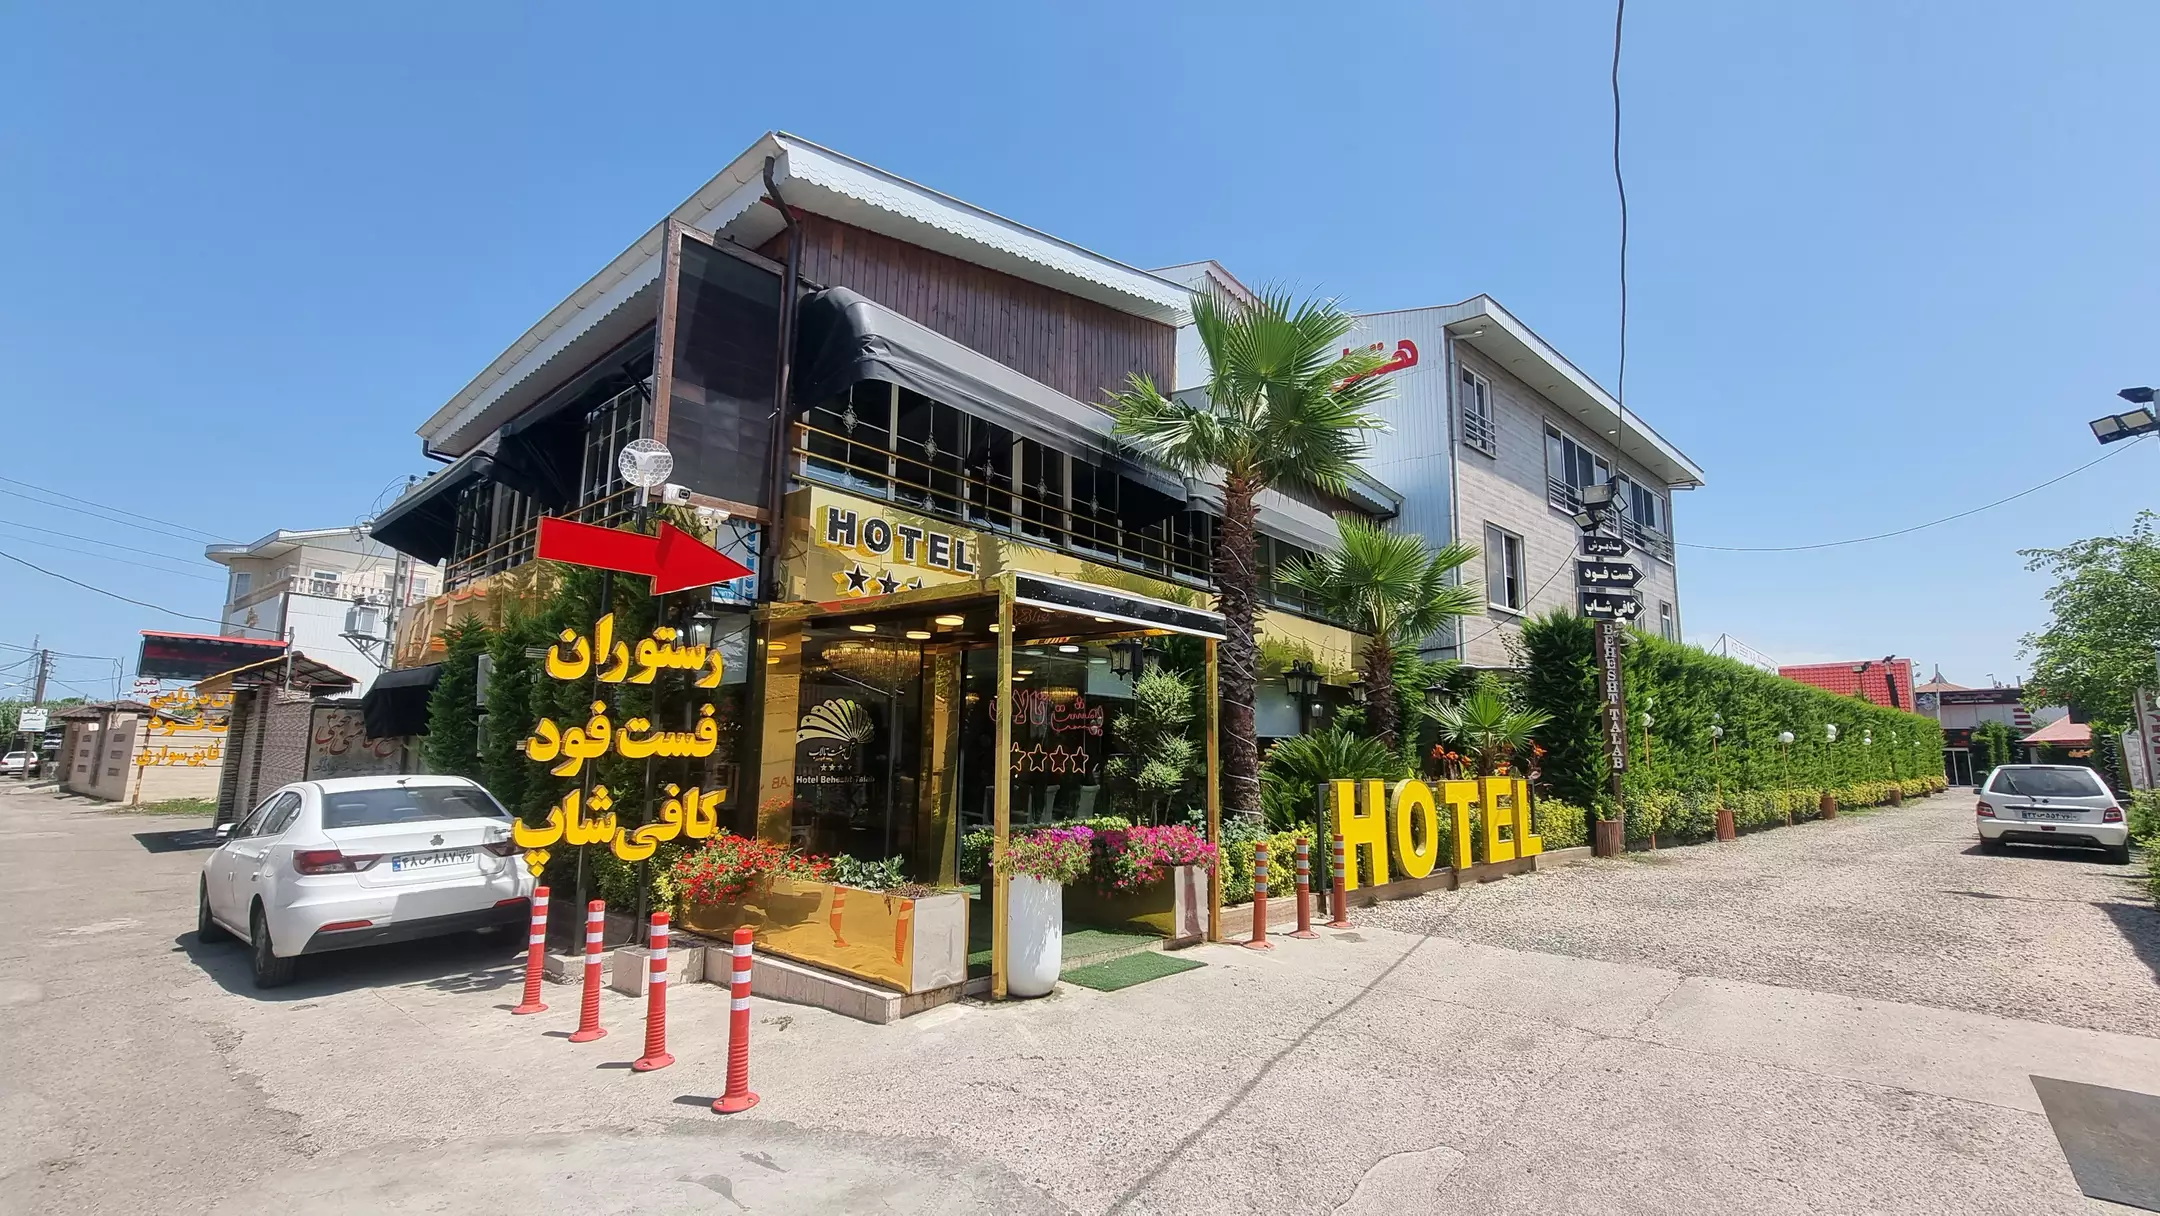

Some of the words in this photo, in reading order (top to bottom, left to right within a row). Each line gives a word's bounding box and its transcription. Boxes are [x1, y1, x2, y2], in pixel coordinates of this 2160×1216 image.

[817, 505, 977, 576] HOTEL
[1588, 540, 1622, 553] پذیرش
[1584, 566, 1609, 582] فود
[1610, 567, 1634, 580] فست
[1585, 598, 1612, 616] شاپ
[1614, 600, 1636, 617] کافی
[546, 612, 724, 689] رستوران
[1603, 623, 1618, 705] BEHESHT
[147, 712, 205, 736] فود
[525, 700, 612, 777] فود
[615, 703, 718, 759] فست
[1609, 708, 1624, 769] TALAB
[796, 775, 819, 784] Hotel
[511, 784, 617, 878] شاپ
[611, 783, 727, 861] کافی
[1329, 776, 1543, 891] HOTEL
